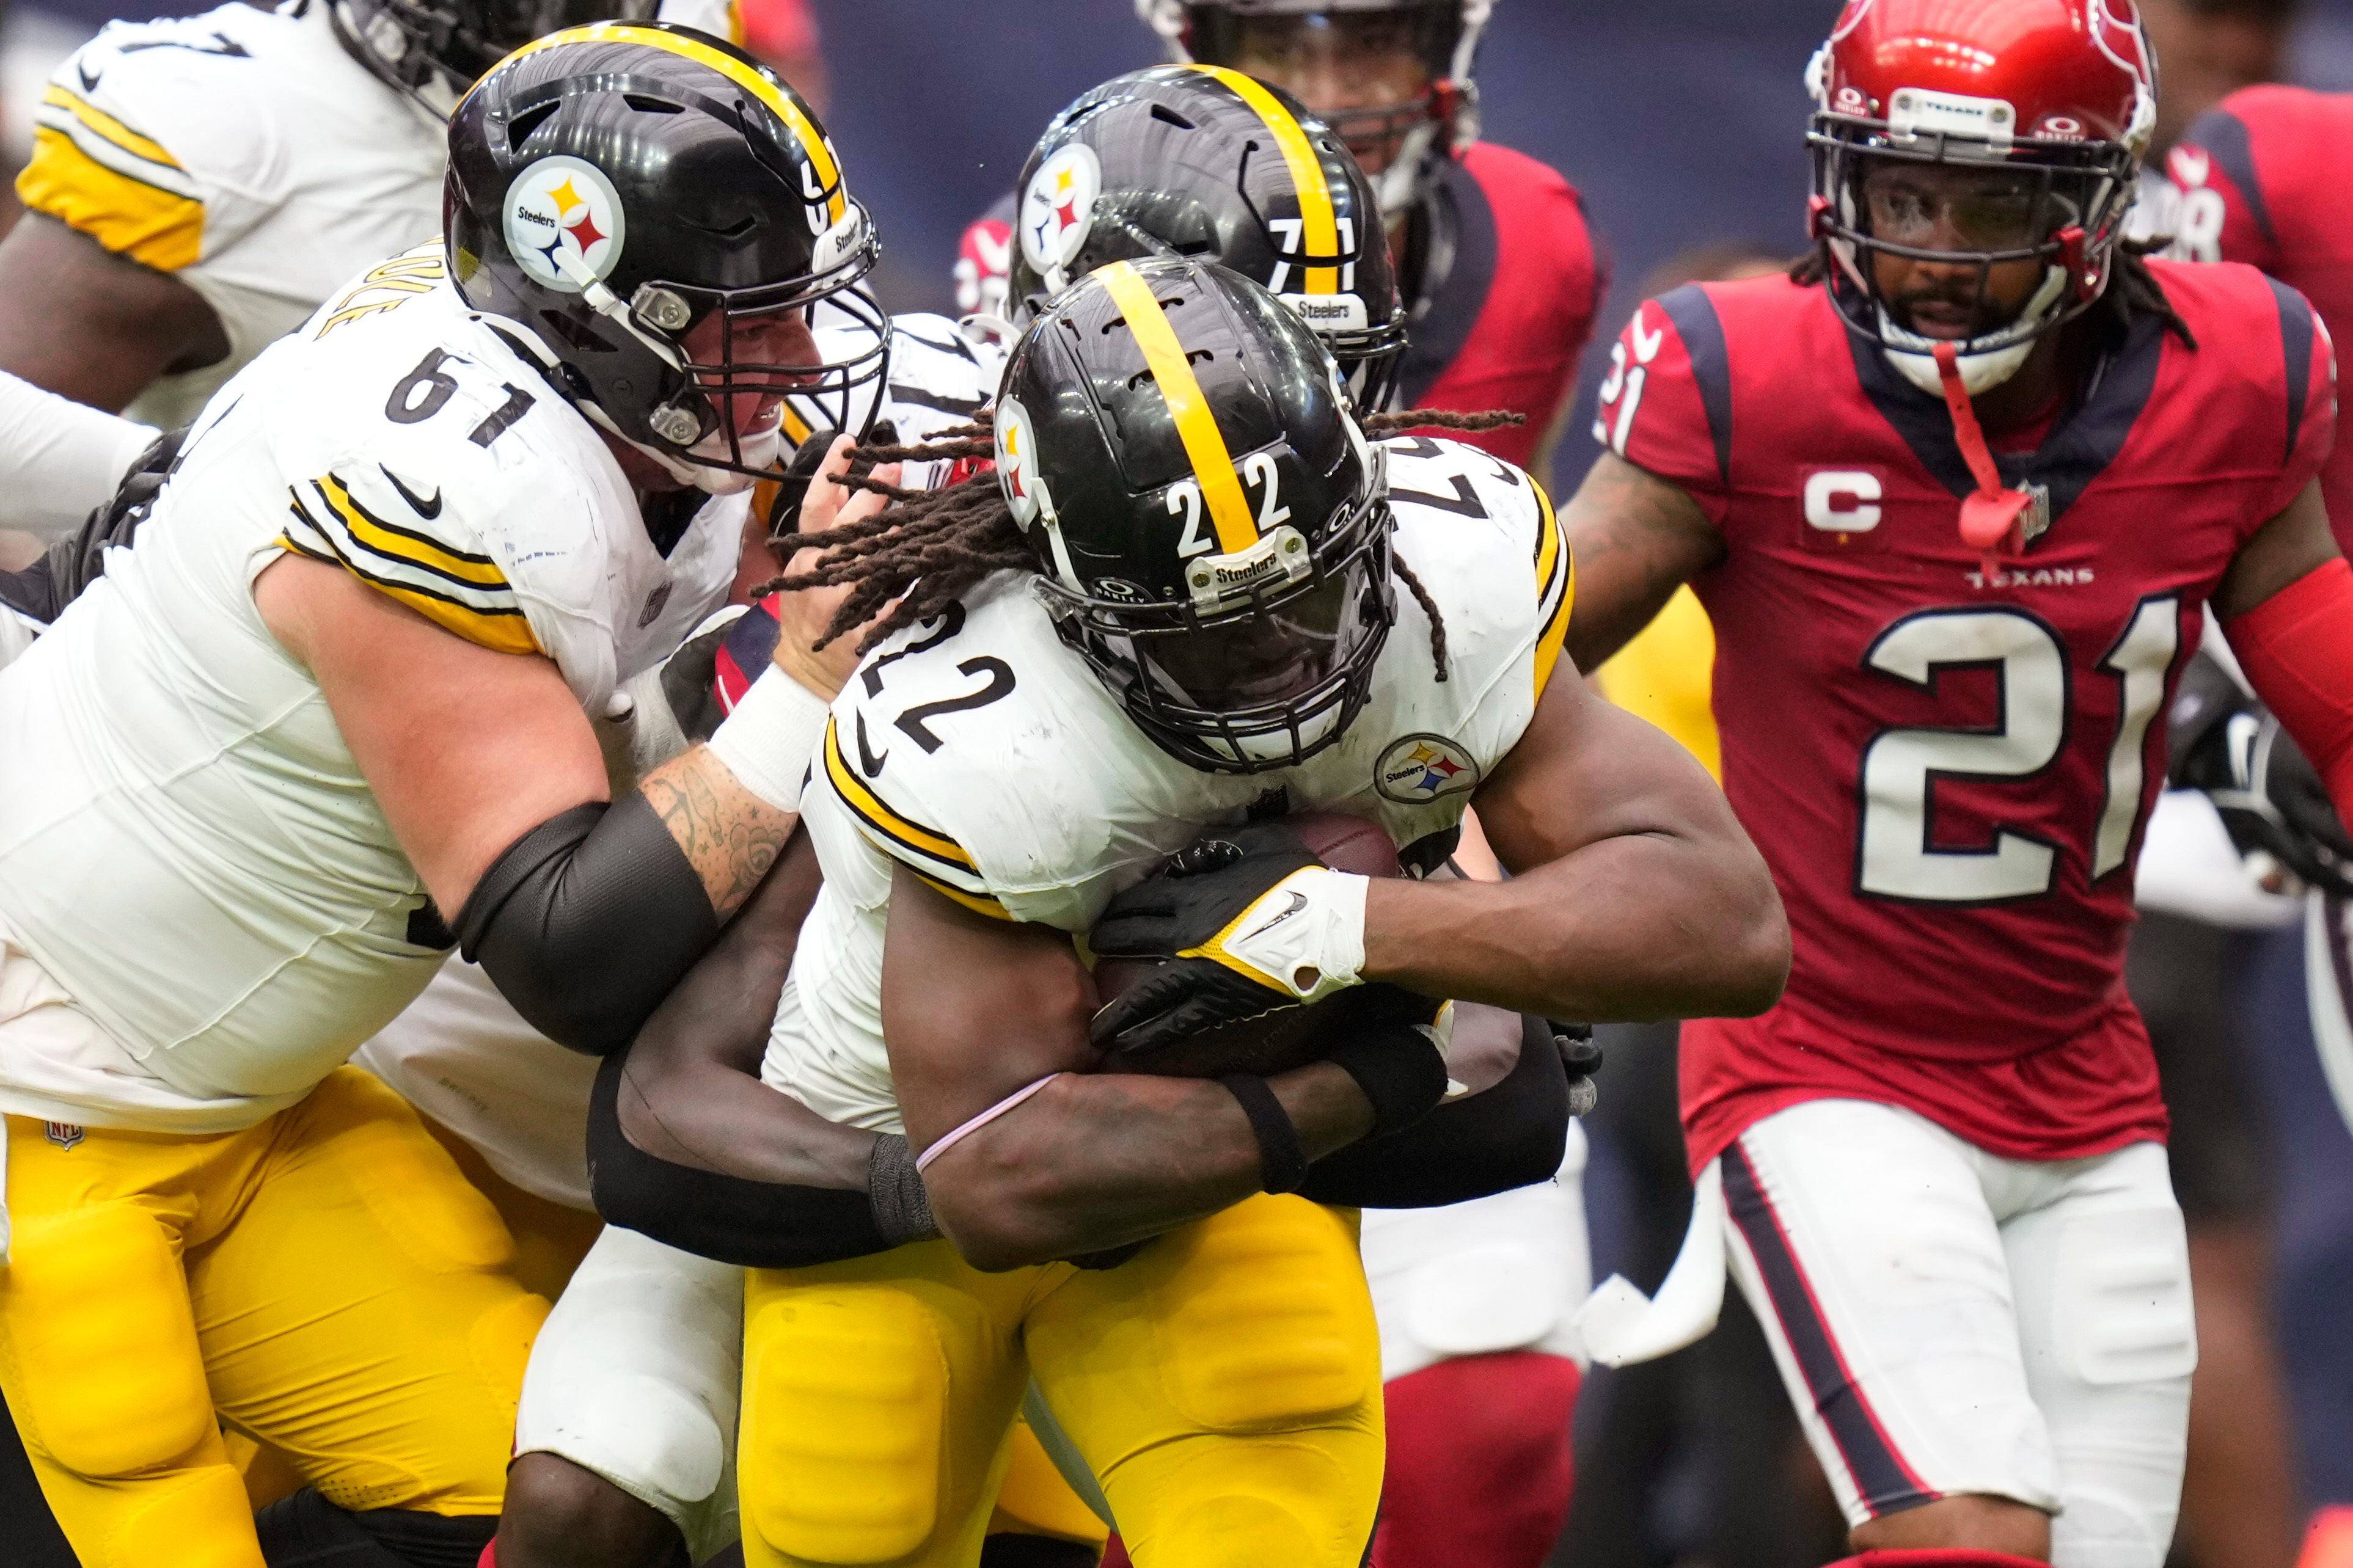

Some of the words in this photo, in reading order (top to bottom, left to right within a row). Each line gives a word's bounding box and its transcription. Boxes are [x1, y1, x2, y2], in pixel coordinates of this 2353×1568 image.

[518, 205, 556, 228] Steelers
[1268, 217, 1356, 294] 71
[1298, 300, 1350, 319] Steelers
[384, 346, 537, 450] 61
[1166, 452, 1292, 559] 22
[1804, 471, 1883, 533] C
[1216, 552, 1277, 584] Steelers
[859, 598, 1017, 756] 22
[1386, 764, 1425, 783] Steelers
[1854, 589, 2184, 905] 21
